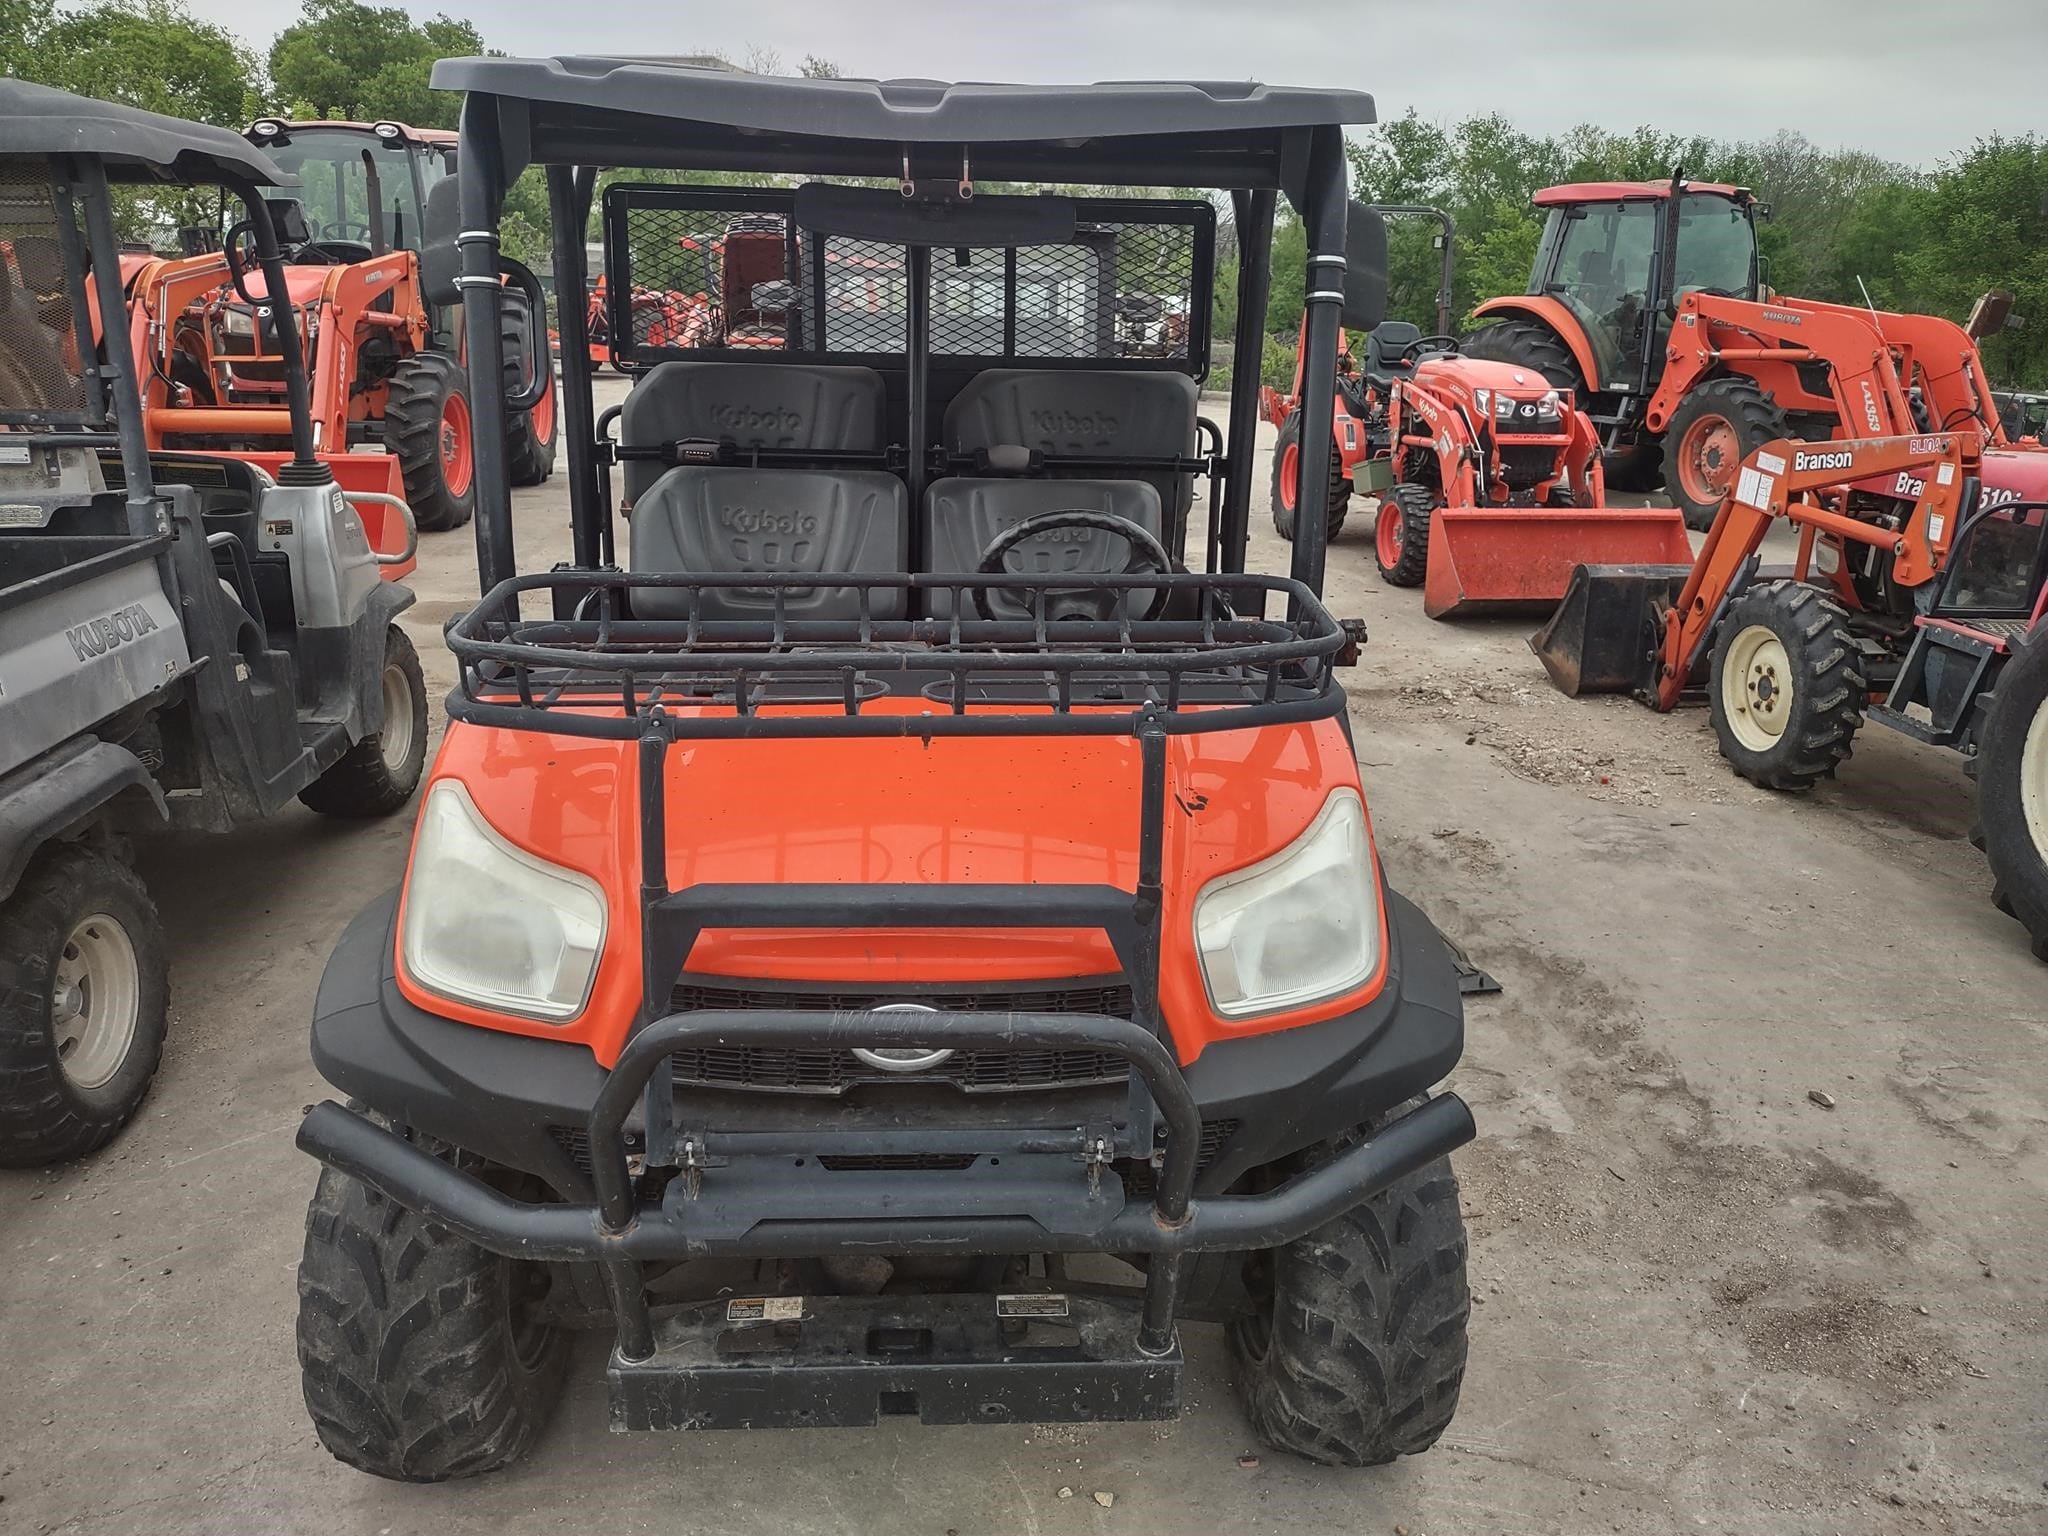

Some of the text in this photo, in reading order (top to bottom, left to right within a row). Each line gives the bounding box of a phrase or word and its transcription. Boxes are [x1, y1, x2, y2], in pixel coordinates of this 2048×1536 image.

[1763, 311, 1801, 325] KUBOTA
[710, 403, 802, 430] Kubota
[1860, 381, 1881, 432] LA1353
[1030, 410, 1119, 434] Kubota
[1794, 451, 1853, 472] Branson
[721, 505, 818, 534] Kubota
[65, 602, 159, 663] KUBOTA
